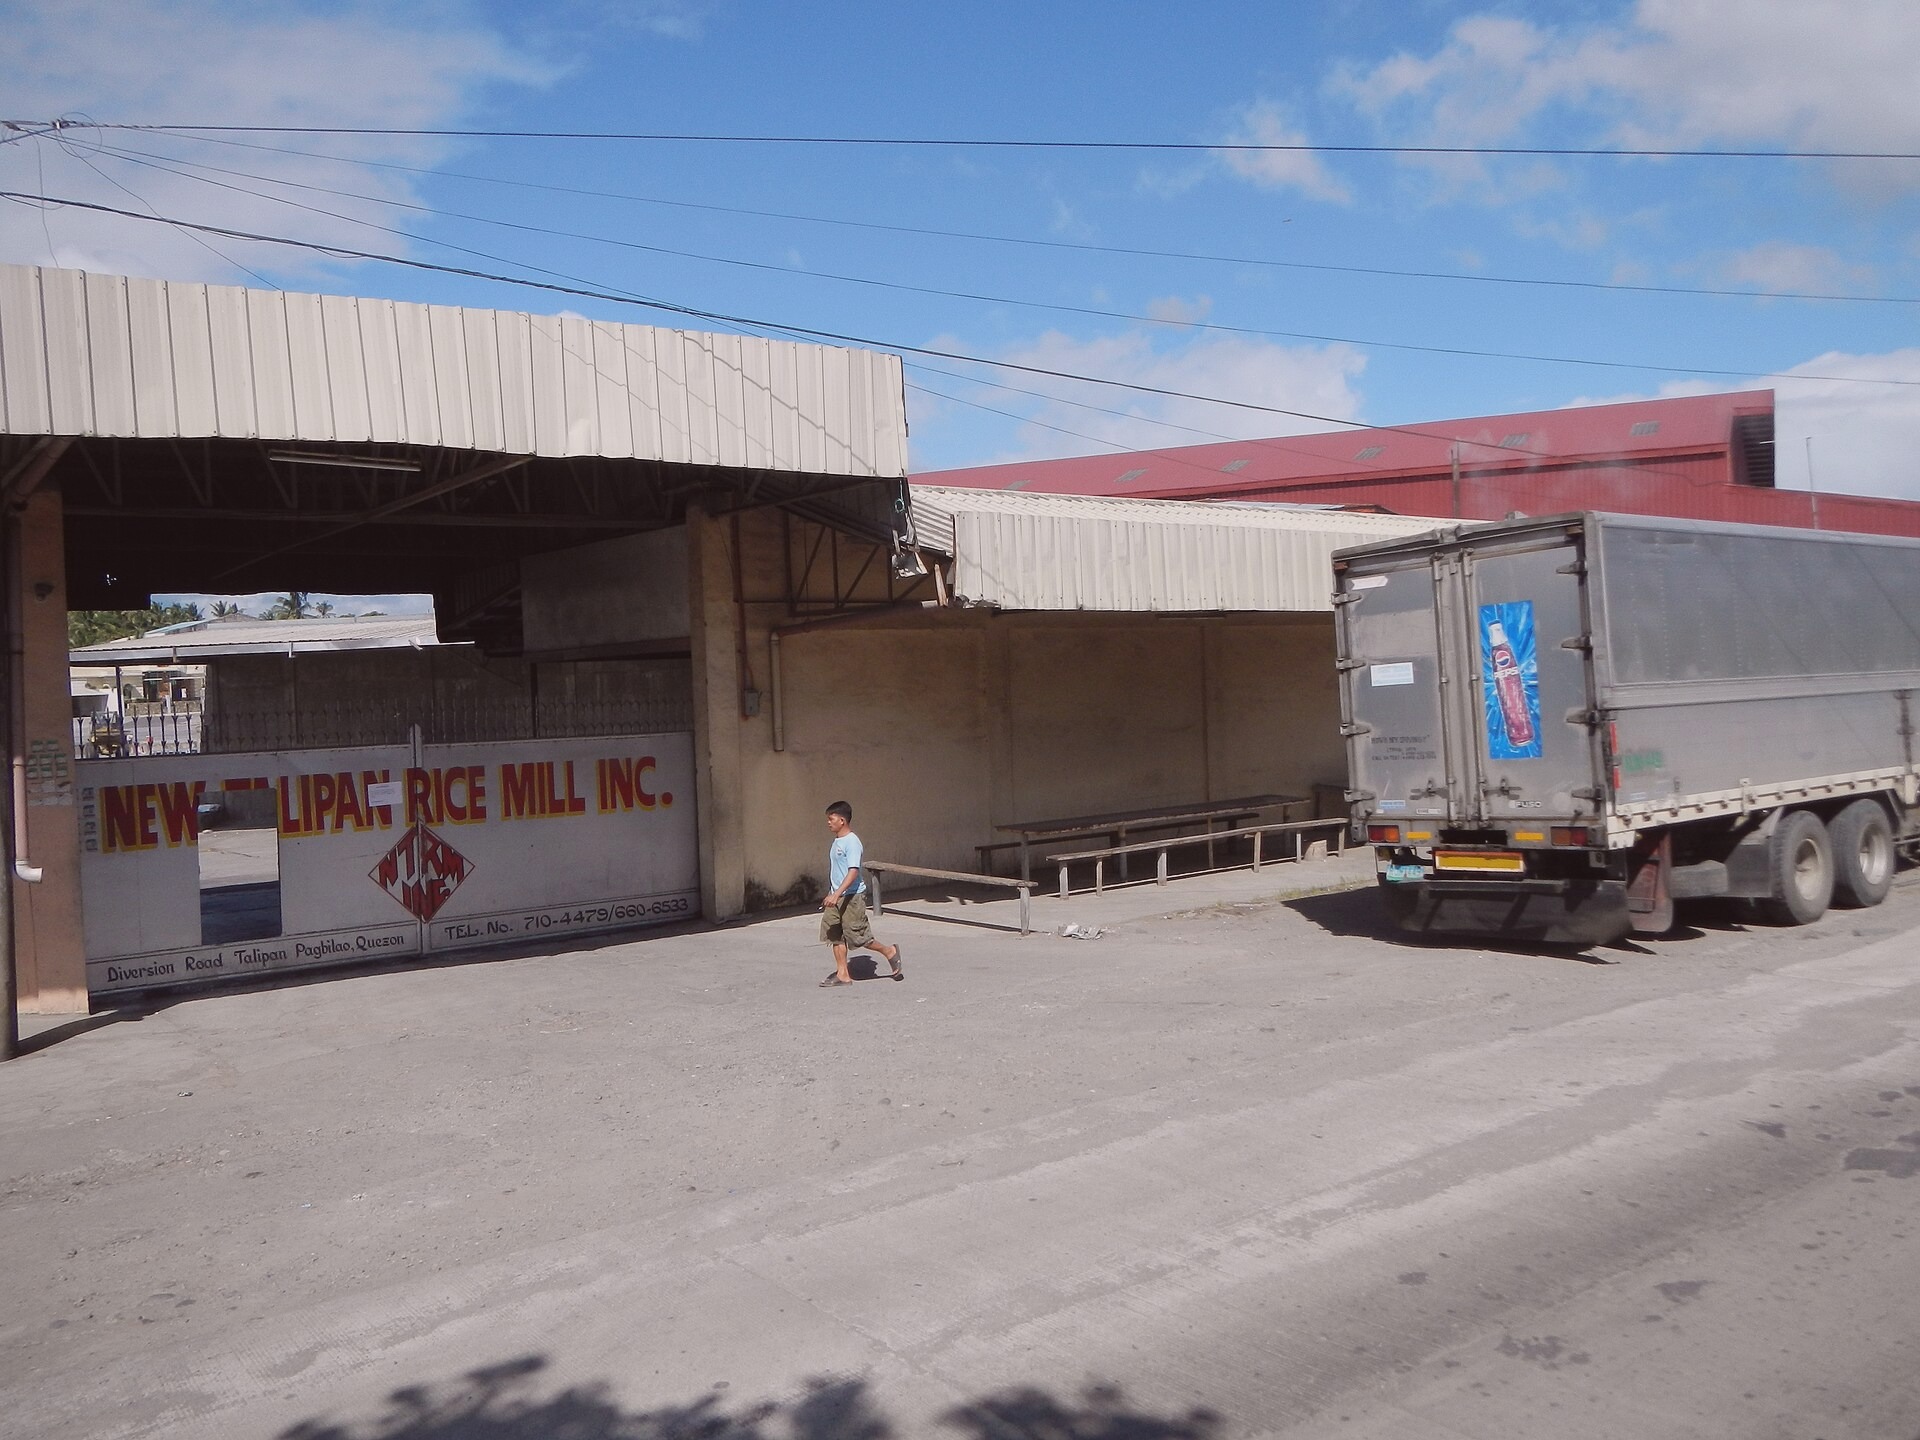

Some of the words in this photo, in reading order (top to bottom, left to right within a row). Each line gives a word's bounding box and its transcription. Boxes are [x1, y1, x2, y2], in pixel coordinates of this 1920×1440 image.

[100, 781, 206, 853] NEW
[405, 765, 487, 827] RICE
[500, 761, 586, 820] MILL
[597, 756, 674, 814] INC.
[378, 825, 465, 889] NTRM
[444, 924, 483, 940] TEL.
[487, 921, 513, 935] No.
[107, 962, 175, 983] Diversion
[185, 952, 223, 971] Road
[234, 949, 287, 967] Talipan
[355, 935, 405, 951] Quezon
